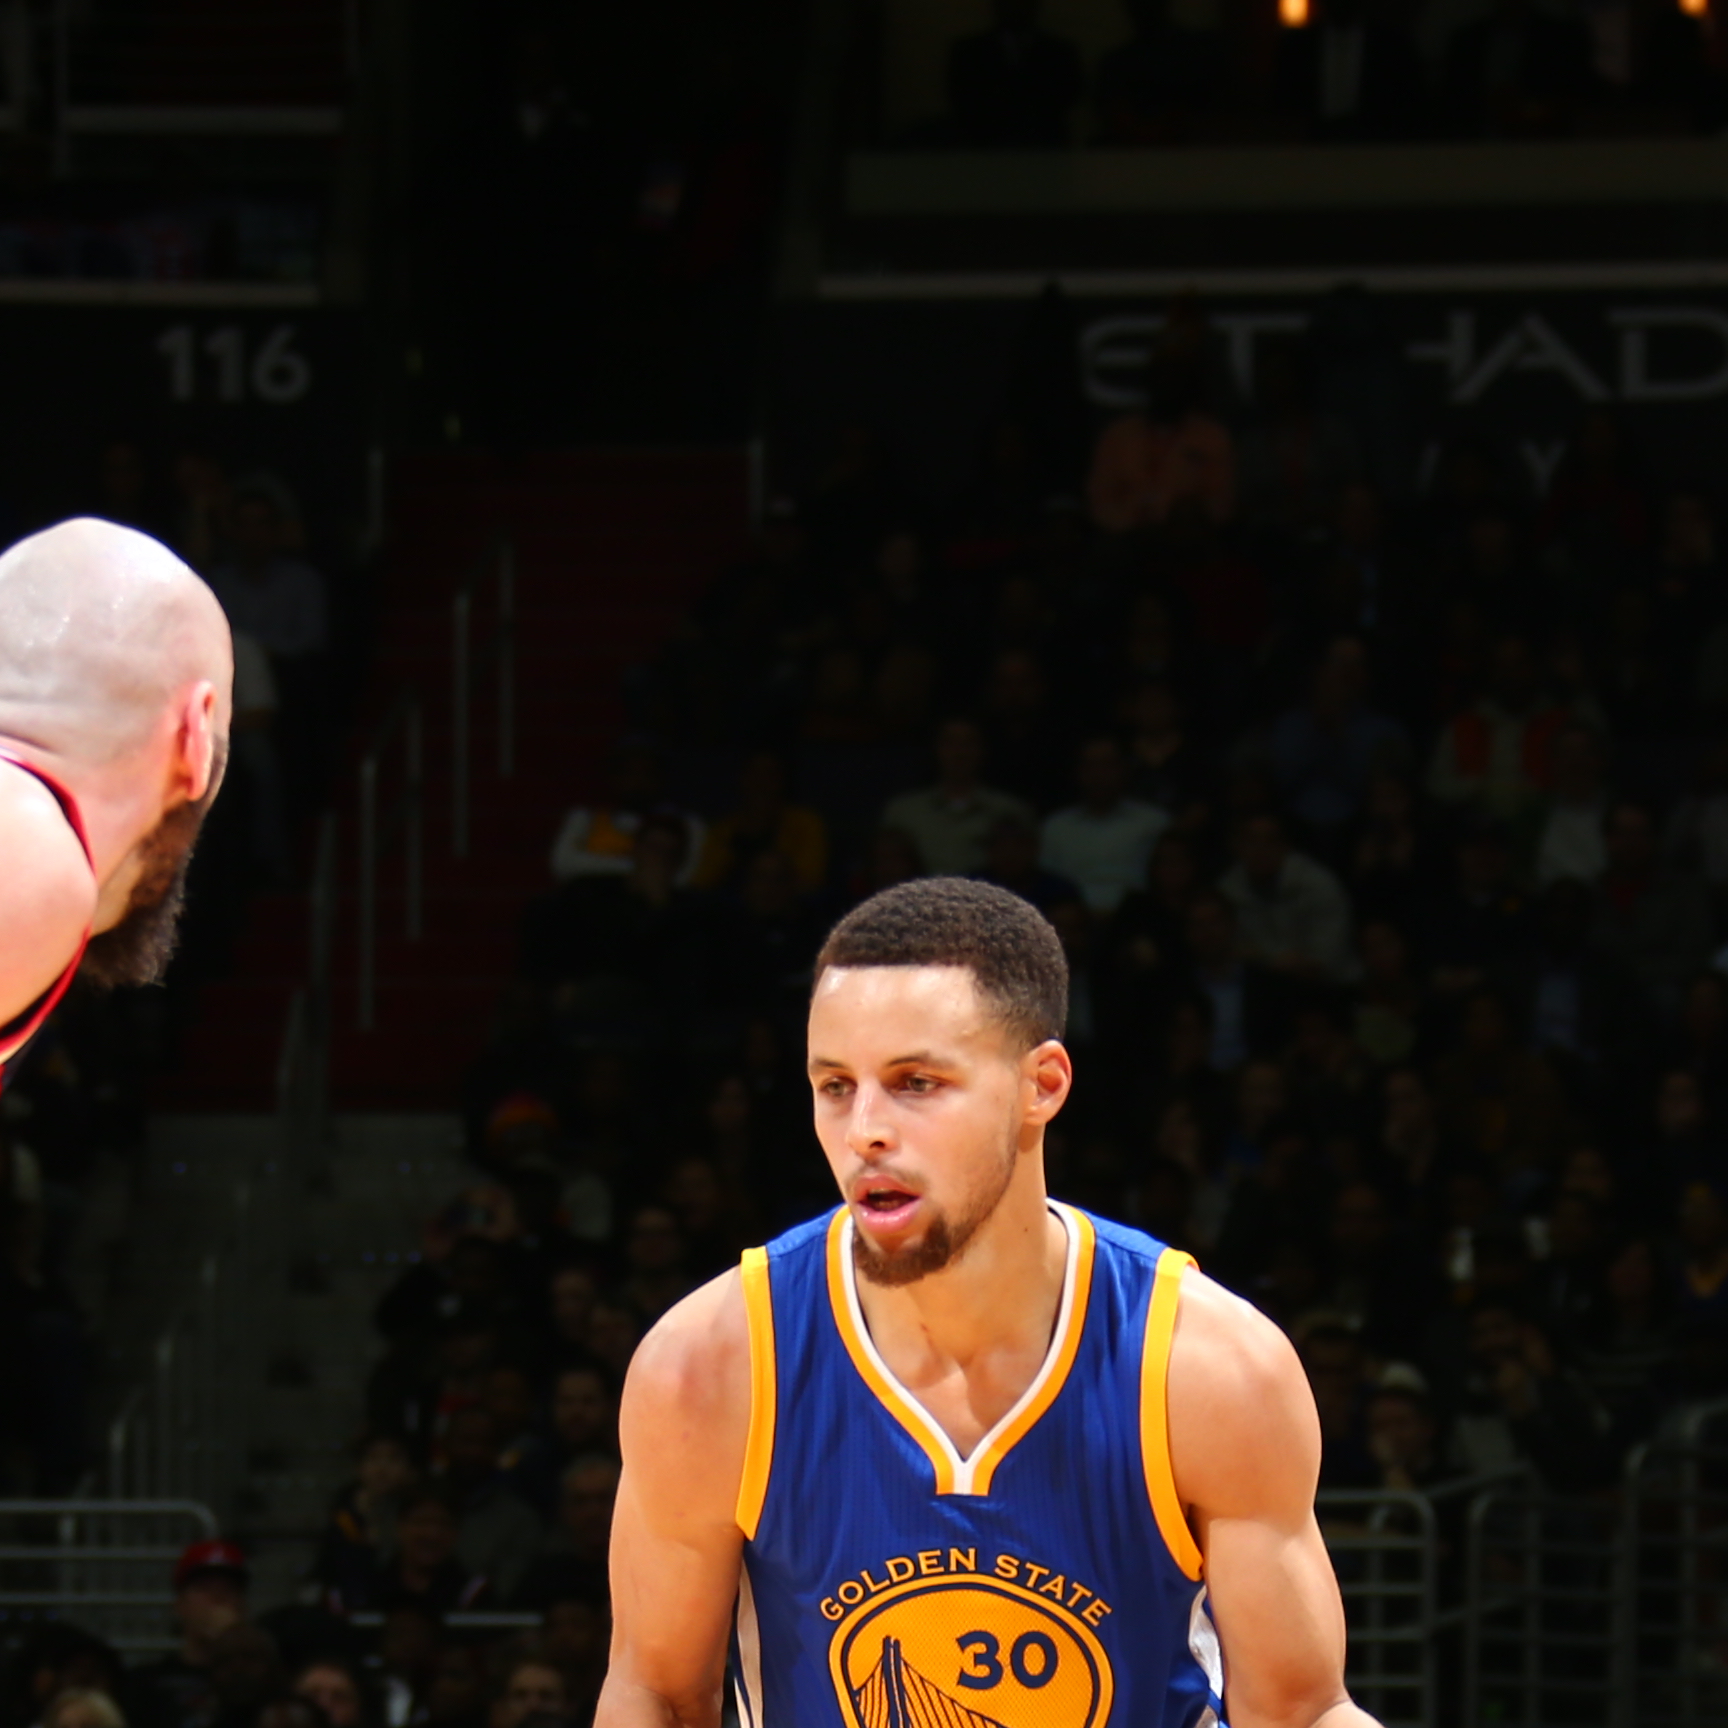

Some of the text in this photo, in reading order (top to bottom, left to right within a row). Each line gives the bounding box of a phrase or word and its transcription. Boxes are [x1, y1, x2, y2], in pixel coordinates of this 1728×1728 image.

[153, 322, 313, 405] 116
[819, 1547, 1113, 1627] GOLDEN STATE
[956, 1630, 1059, 1690] 30
